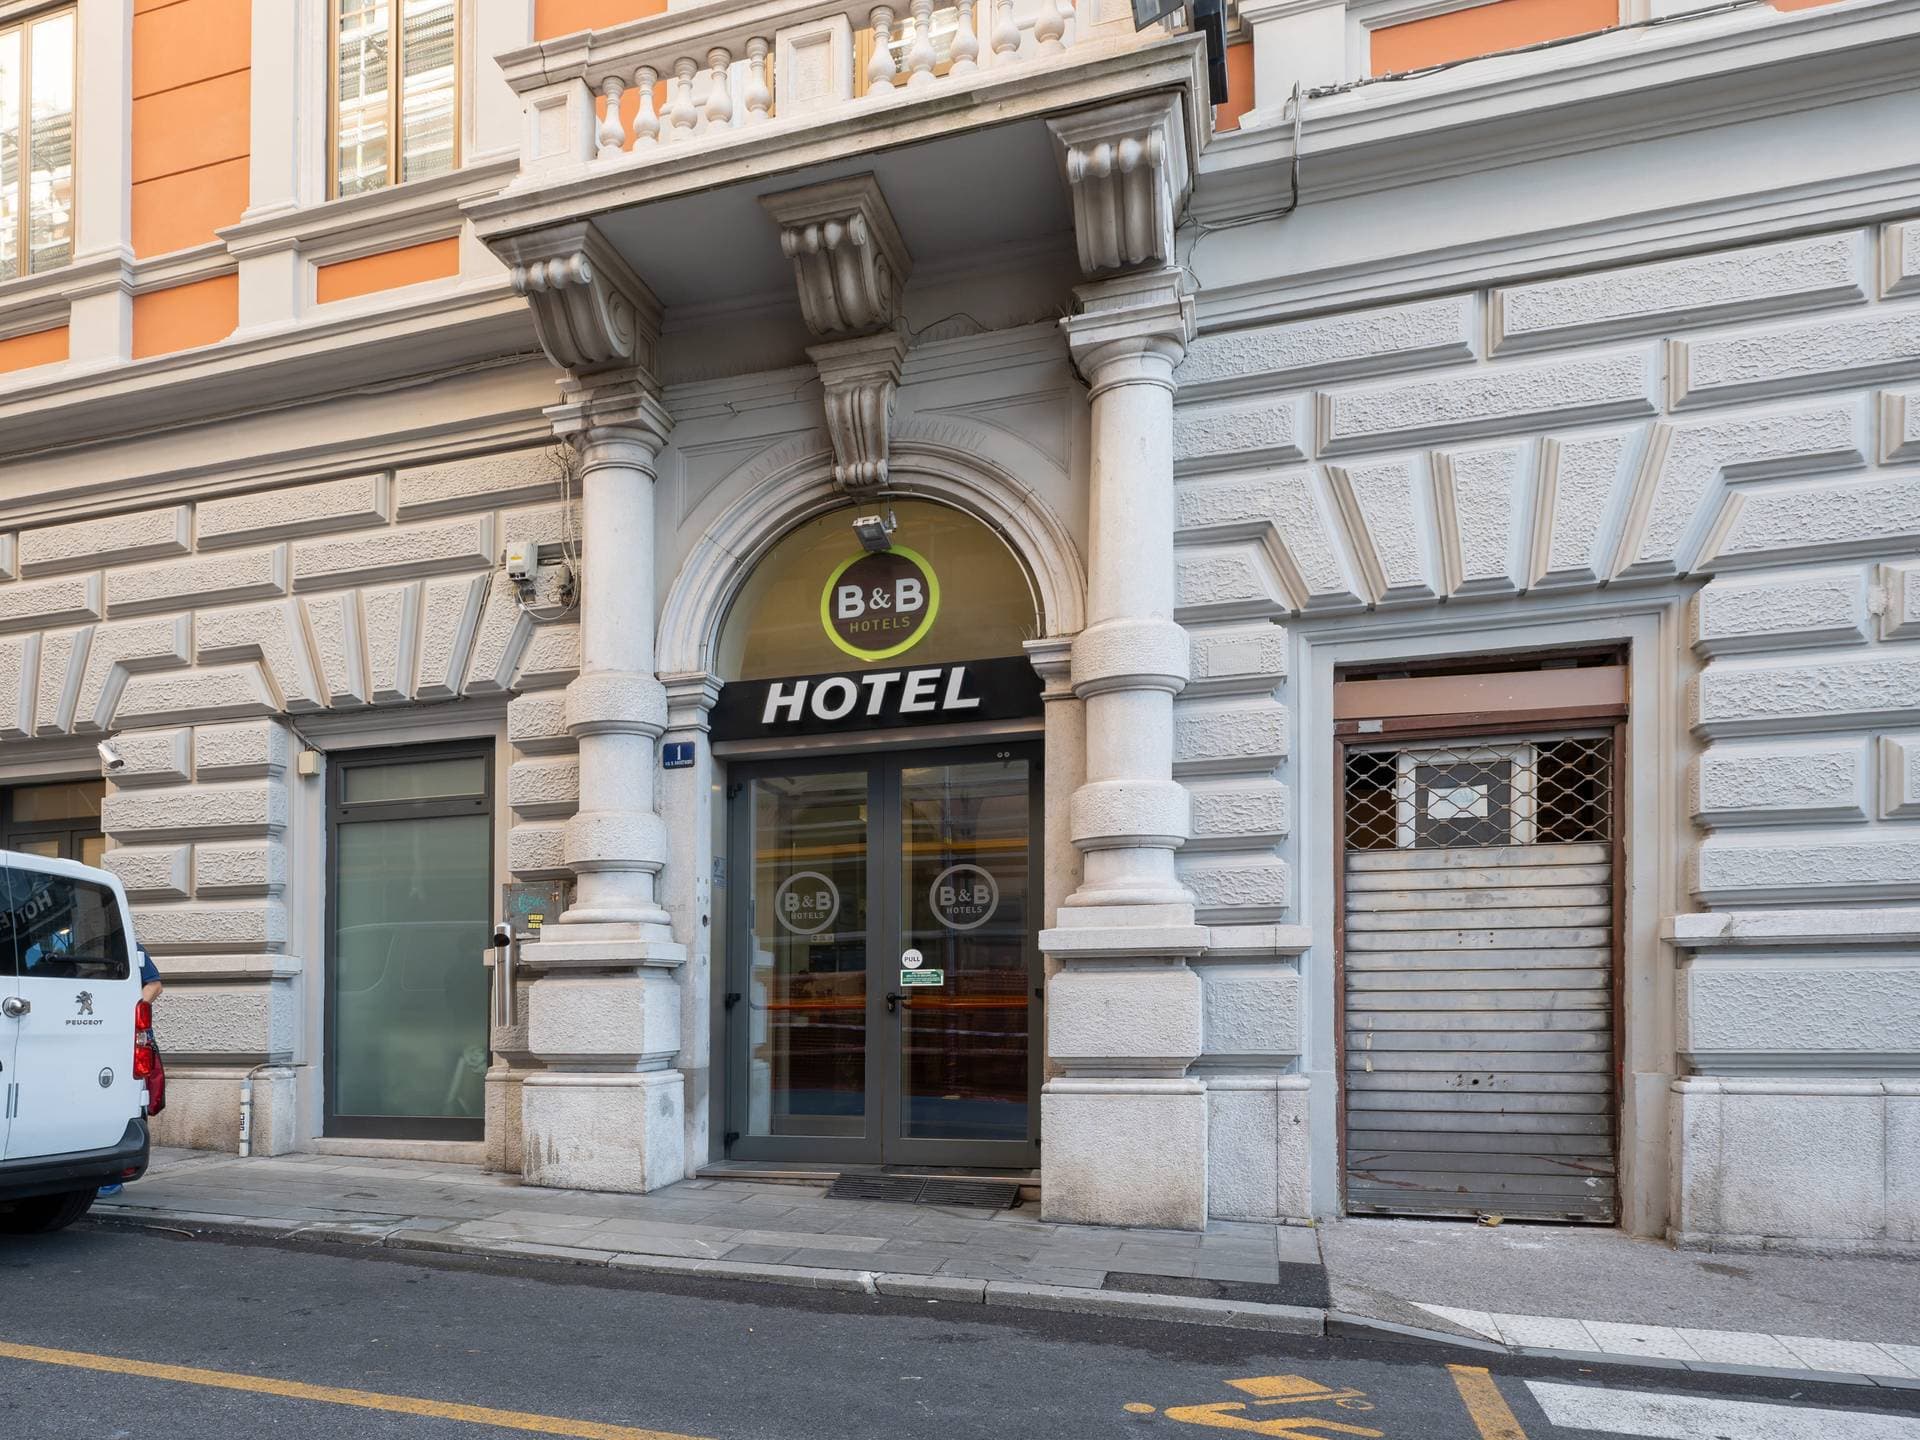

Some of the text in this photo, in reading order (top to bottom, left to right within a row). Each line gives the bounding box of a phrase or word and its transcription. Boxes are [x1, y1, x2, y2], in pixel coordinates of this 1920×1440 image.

[838, 577, 924, 619] B&B
[849, 616, 911, 633] HOTELS
[762, 666, 980, 724] HOTEL
[677, 744, 681, 760] 1
[784, 891, 832, 912] B&B
[940, 885, 991, 906] B&B
[791, 911, 825, 920] HOTELS
[946, 905, 983, 914] HOTELS
